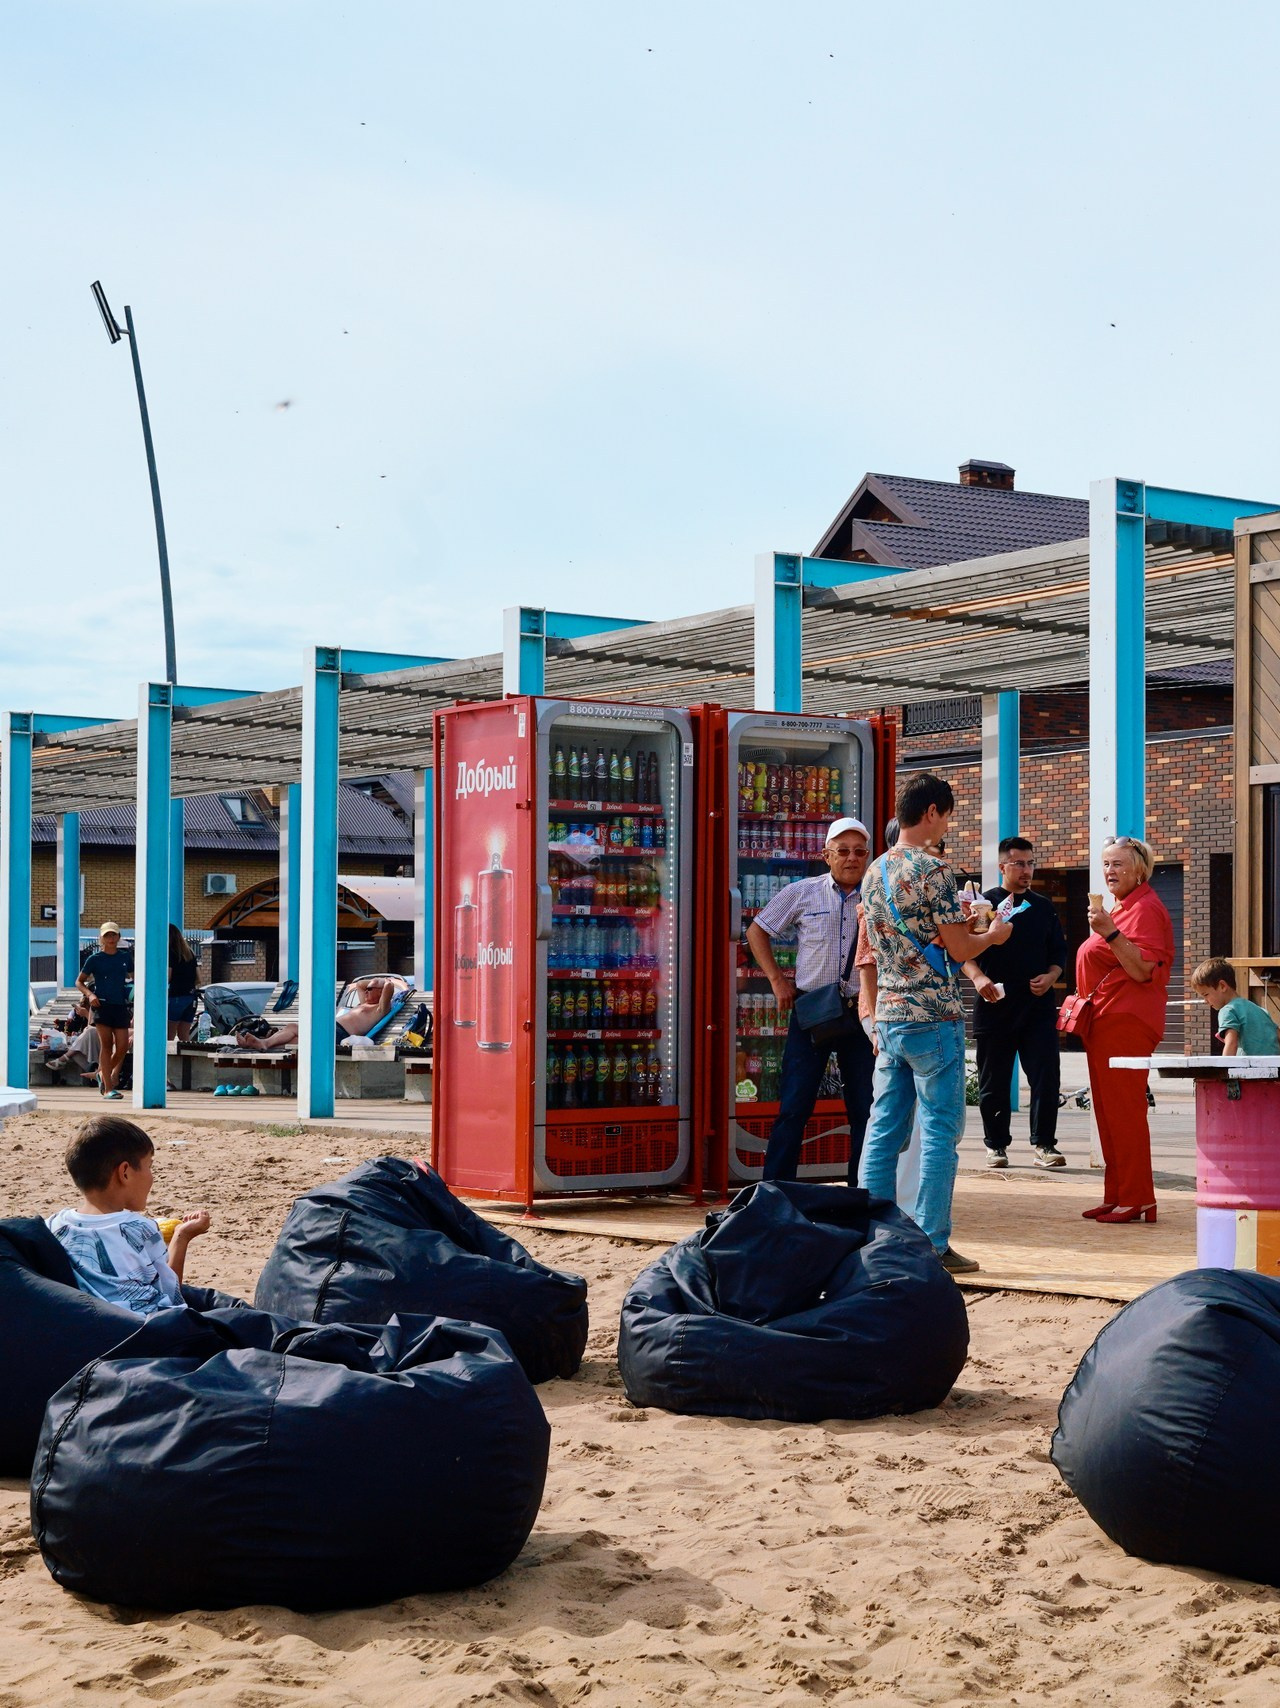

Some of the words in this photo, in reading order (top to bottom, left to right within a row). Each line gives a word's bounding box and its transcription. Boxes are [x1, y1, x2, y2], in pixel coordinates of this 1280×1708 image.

[570, 706, 575, 714] 8
[576, 706, 594, 714] 800
[594, 707, 612, 715] 700
[612, 708, 632, 717] 7777
[456, 755, 518, 800] Добрый
[477, 941, 512, 970] Добрый
